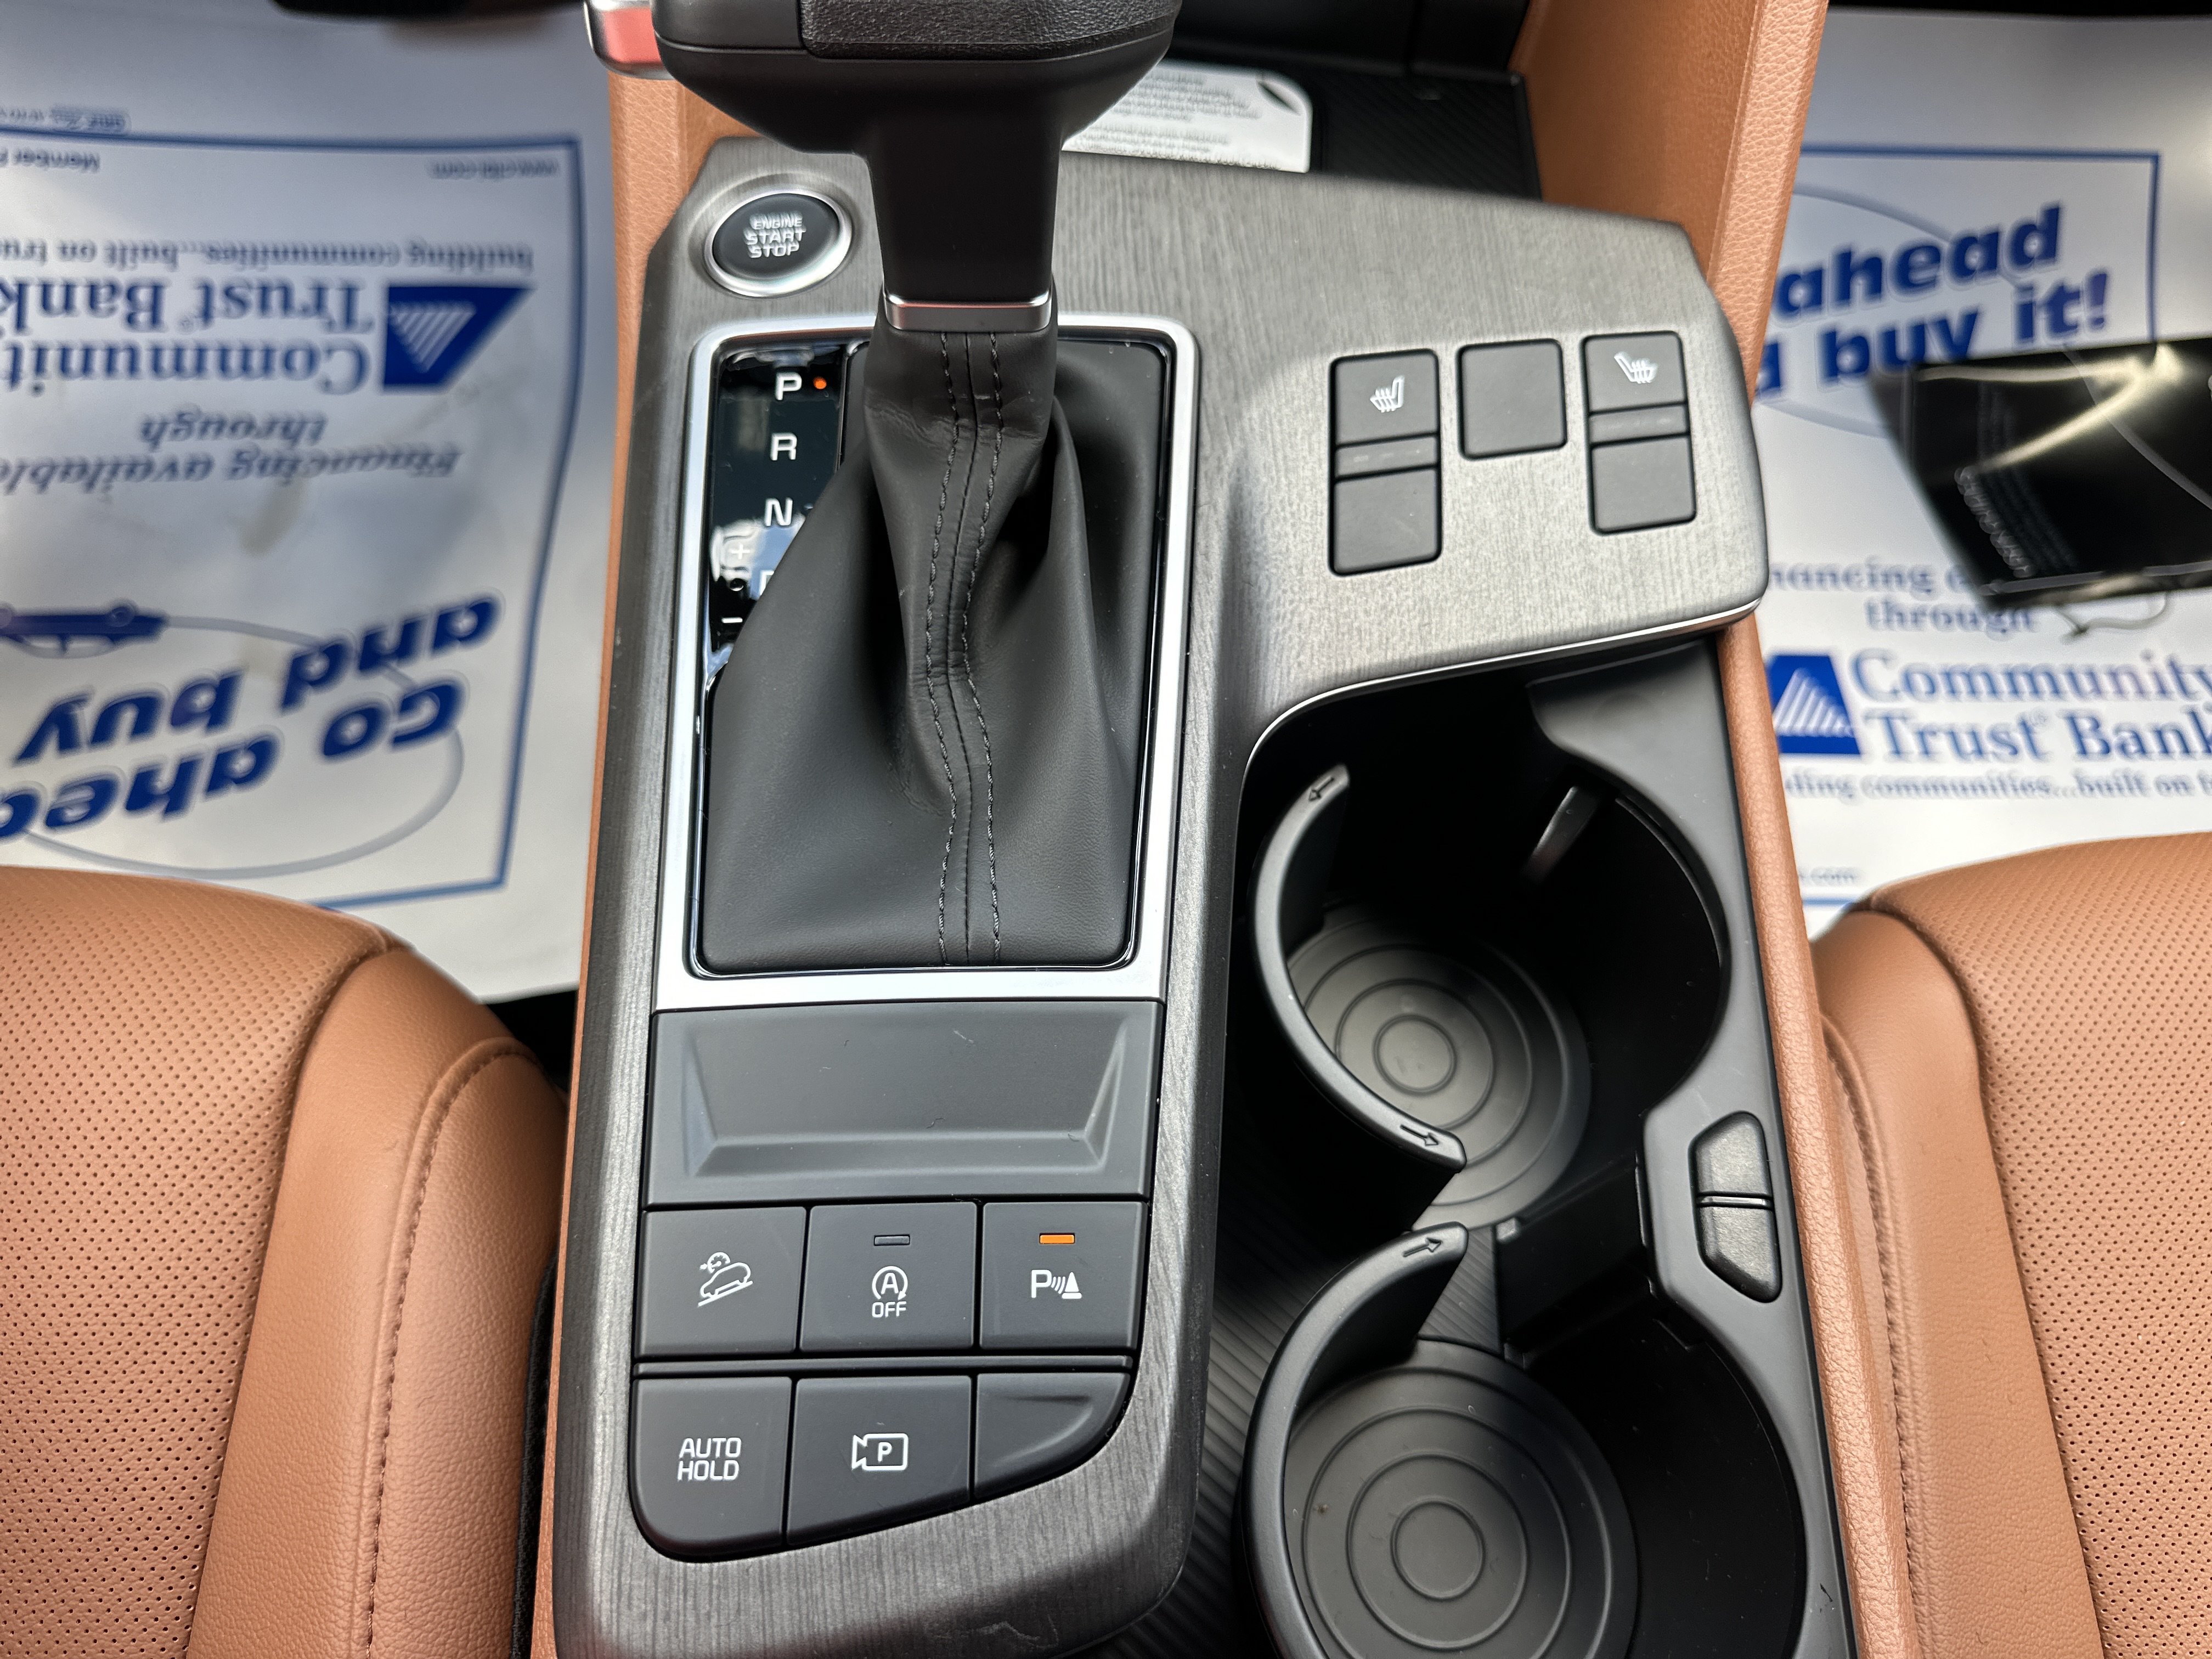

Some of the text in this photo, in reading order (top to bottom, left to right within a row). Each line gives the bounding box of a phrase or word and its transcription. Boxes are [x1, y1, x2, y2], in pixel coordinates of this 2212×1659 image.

[749, 211, 803, 230] ENGINE
[744, 226, 806, 245] START
[747, 241, 799, 258] STOP
[0, 240, 48, 266] tru
[1772, 202, 2063, 325] ahead
[2012, 267, 2111, 348] it!
[4, 336, 372, 397] Communit
[775, 372, 802, 400] P
[140, 403, 328, 452] through
[770, 432, 797, 461] R
[224, 439, 464, 485] Financing
[765, 498, 793, 526] N
[1769, 555, 1942, 600] nancing
[14, 595, 504, 766] and buy
[322, 678, 466, 763] Go
[1031, 1269, 1052, 1299] P
[872, 1301, 907, 1318] OFF
[679, 1437, 742, 1458] AUTO
[877, 1442, 893, 1462] P
[677, 1460, 740, 1481] HOLD
